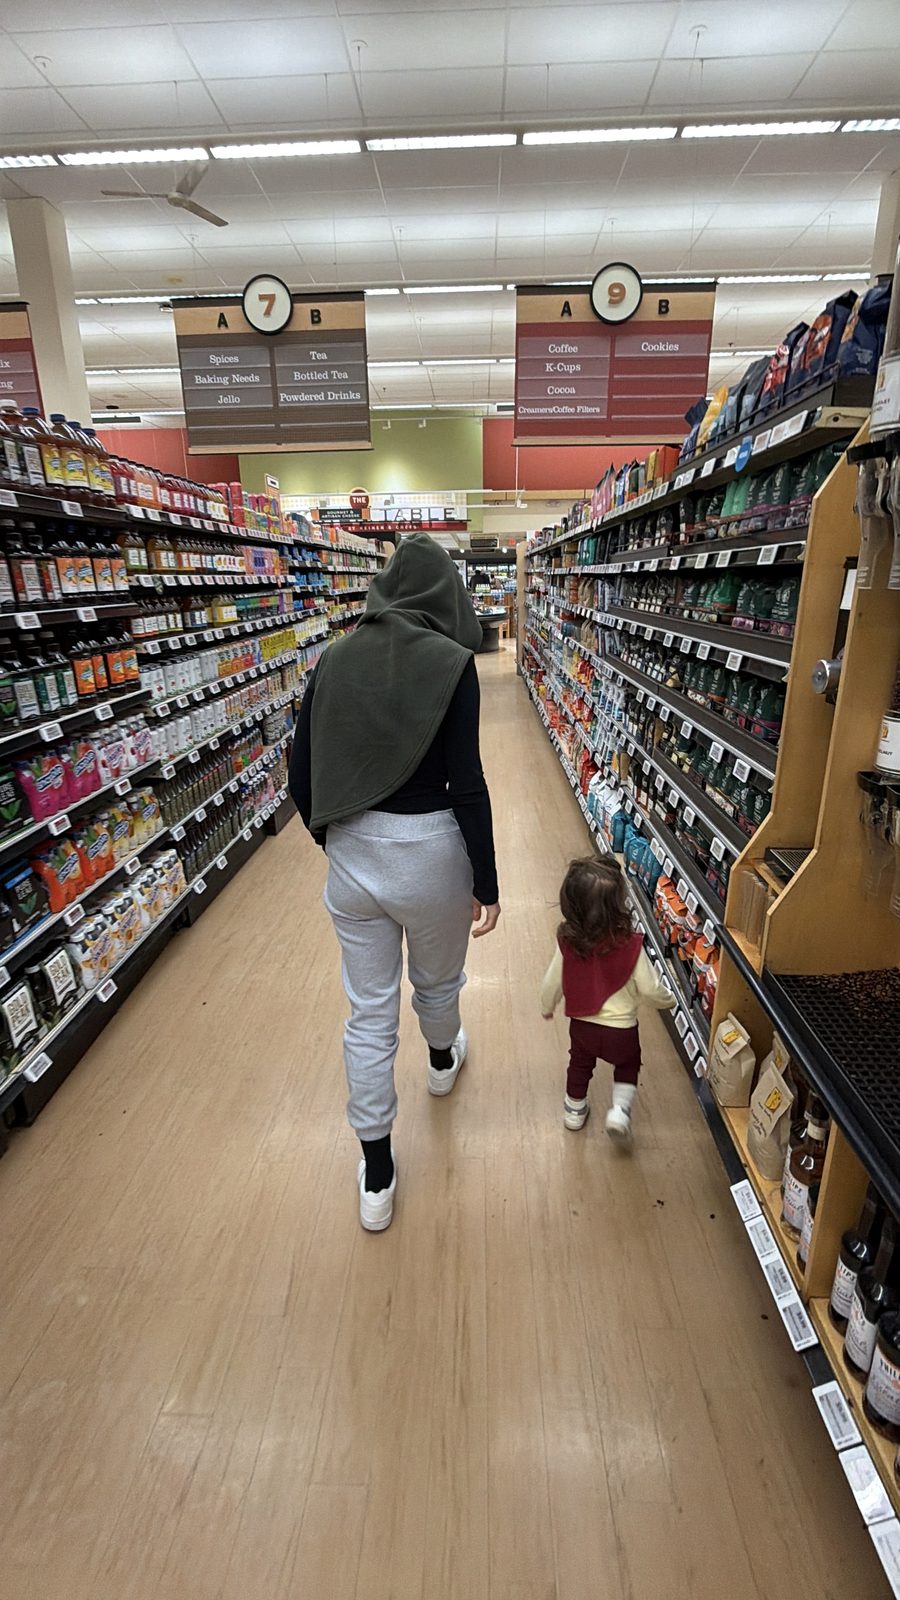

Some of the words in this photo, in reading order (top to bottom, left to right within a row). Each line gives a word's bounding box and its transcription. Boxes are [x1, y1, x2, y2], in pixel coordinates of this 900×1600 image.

[607, 282, 626, 305] 9
[258, 294, 276, 317] 7
[561, 301, 572, 317] A
[658, 299, 670, 315] B
[217, 312, 229, 328] A
[310, 309, 322, 325] B
[548, 344, 578, 353] Coffee
[641, 342, 680, 352] Cookies
[209, 354, 239, 366] Spices
[310, 351, 328, 360] Tea
[545, 363, 581, 374] K-Cups
[194, 374, 229, 386] Baking
[232, 373, 260, 383] Needs
[293, 371, 328, 381] Bottled
[331, 370, 349, 379] Tea
[280, 392, 325, 402] Powdered
[327, 390, 361, 400] Drinks
[547, 386, 576, 395] Cocoa
[217, 395, 241, 404] Jello
[576, 405, 601, 413] Filters
[352, 496, 367, 504] THE
